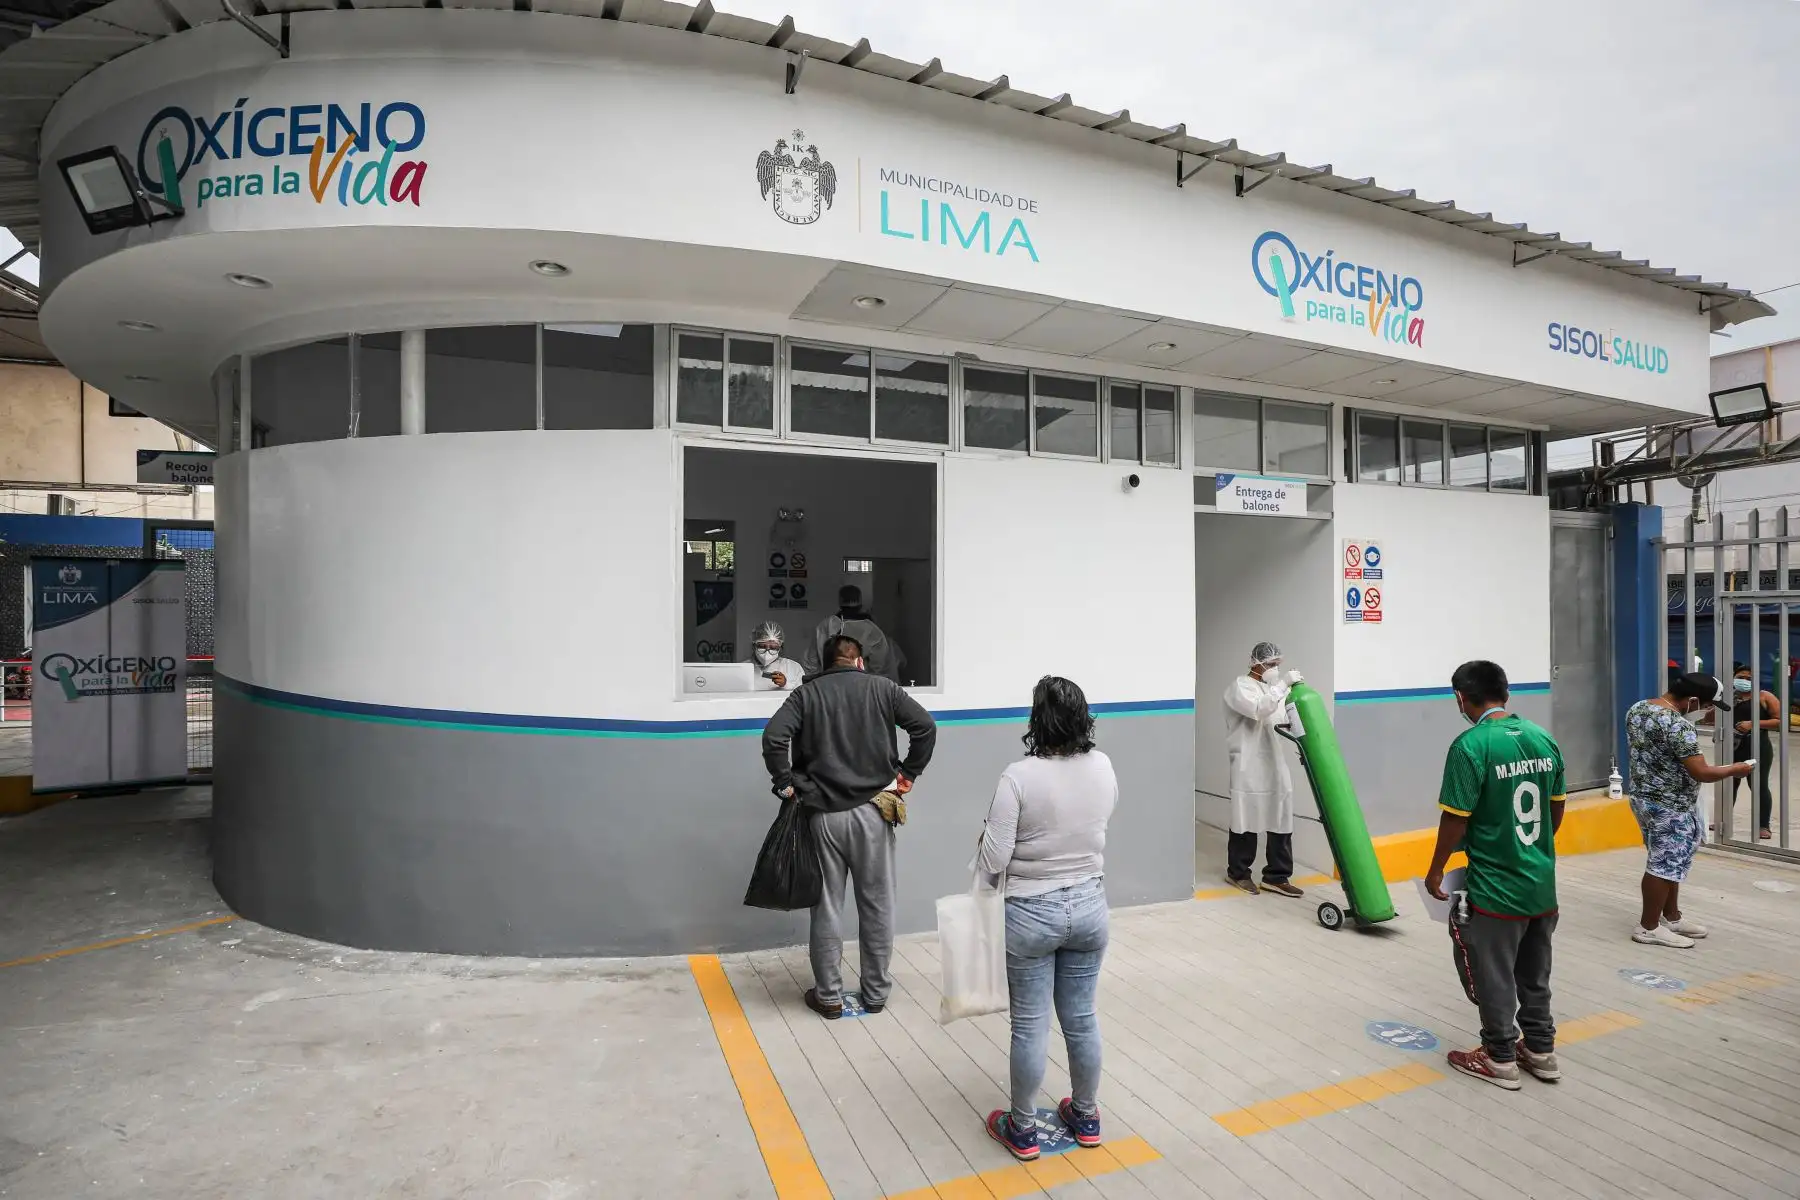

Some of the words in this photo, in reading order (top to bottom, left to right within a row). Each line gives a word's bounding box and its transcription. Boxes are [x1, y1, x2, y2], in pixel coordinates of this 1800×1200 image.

[137, 97, 426, 194] OXÍGENO
[197, 170, 263, 208] para
[273, 165, 300, 194] la
[309, 132, 427, 206] Vida
[880, 168, 1013, 208] MUNICIPALIDAD
[1018, 198, 1038, 213] DE
[880, 190, 1039, 262] LIMA
[1251, 231, 1423, 311] OXÍGENO
[1306, 300, 1346, 323] para
[1350, 304, 1365, 327] la
[1368, 290, 1425, 348] Vida
[1548, 322, 1608, 361] SISOL
[1613, 337, 1669, 374] SALUD
[165, 461, 208, 474] Recojo
[171, 472, 214, 484] balone
[1235, 486, 1273, 501] Entrega
[1274, 489, 1286, 499] de
[1242, 499, 1280, 512] balones
[43, 592, 98, 604] LIMA
[40, 653, 176, 681] OXÍGENO
[81, 674, 112, 687] para
[116, 674, 129, 684] la
[132, 664, 177, 687] Vida
[1513, 780, 1541, 846] 9
